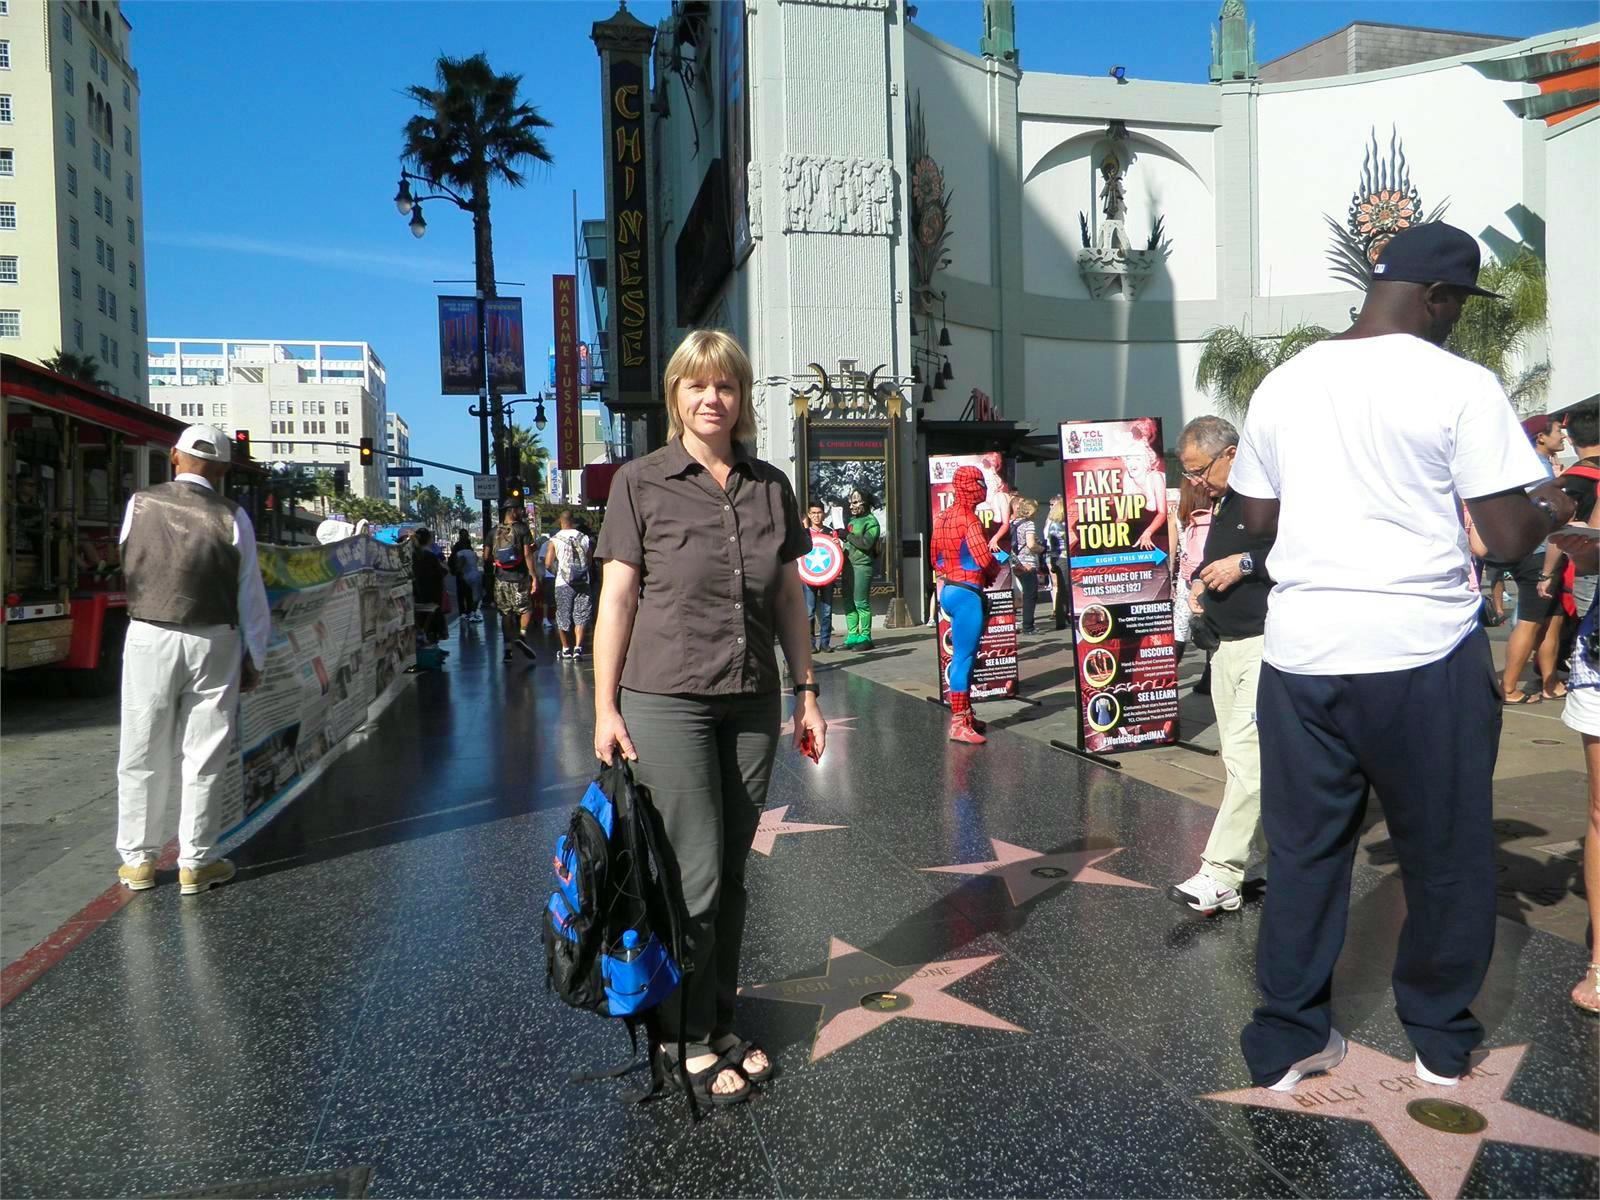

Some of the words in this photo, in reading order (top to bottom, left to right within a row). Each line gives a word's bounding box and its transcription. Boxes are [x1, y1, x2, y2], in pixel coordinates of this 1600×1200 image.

[615, 85, 645, 367] CHINESE
[559, 279, 572, 357] MADAME
[562, 364, 573, 466] TUSSAUDS
[1083, 430, 1103, 438] TCL
[1072, 469, 1123, 496] TAKE
[937, 492, 955, 512] TA
[1075, 496, 1112, 522] THE
[1113, 494, 1147, 520] VIP
[1076, 522, 1131, 550] TOUR
[1095, 556, 1117, 564] RIGHT
[1082, 574, 1104, 585] MOVIE
[1104, 572, 1130, 583] PALACE
[1130, 571, 1138, 581] OF
[1139, 570, 1153, 580] THE
[986, 590, 1013, 600] PERIENCE
[1082, 586, 1104, 596] STARS
[1105, 584, 1126, 594] SINCE
[1126, 582, 1142, 592] 1927
[1130, 602, 1171, 615] EXPERIENCE
[988, 624, 1015, 634] DISCOVER
[1140, 646, 1174, 658] DISCOVER
[985, 658, 996, 667] SEE
[1000, 656, 1016, 666] LEARN
[1138, 692, 1150, 702] SEE
[1150, 691, 1156, 700] &
[1156, 689, 1176, 700] LEARN
[1103, 730, 1166, 746] #WorldsBiggestIMAX
[783, 981, 834, 998] BASIL
[847, 965, 955, 989] RATHBONE
[1289, 1083, 1367, 1109] BILLY
[1378, 1066, 1500, 1093] CRAL
